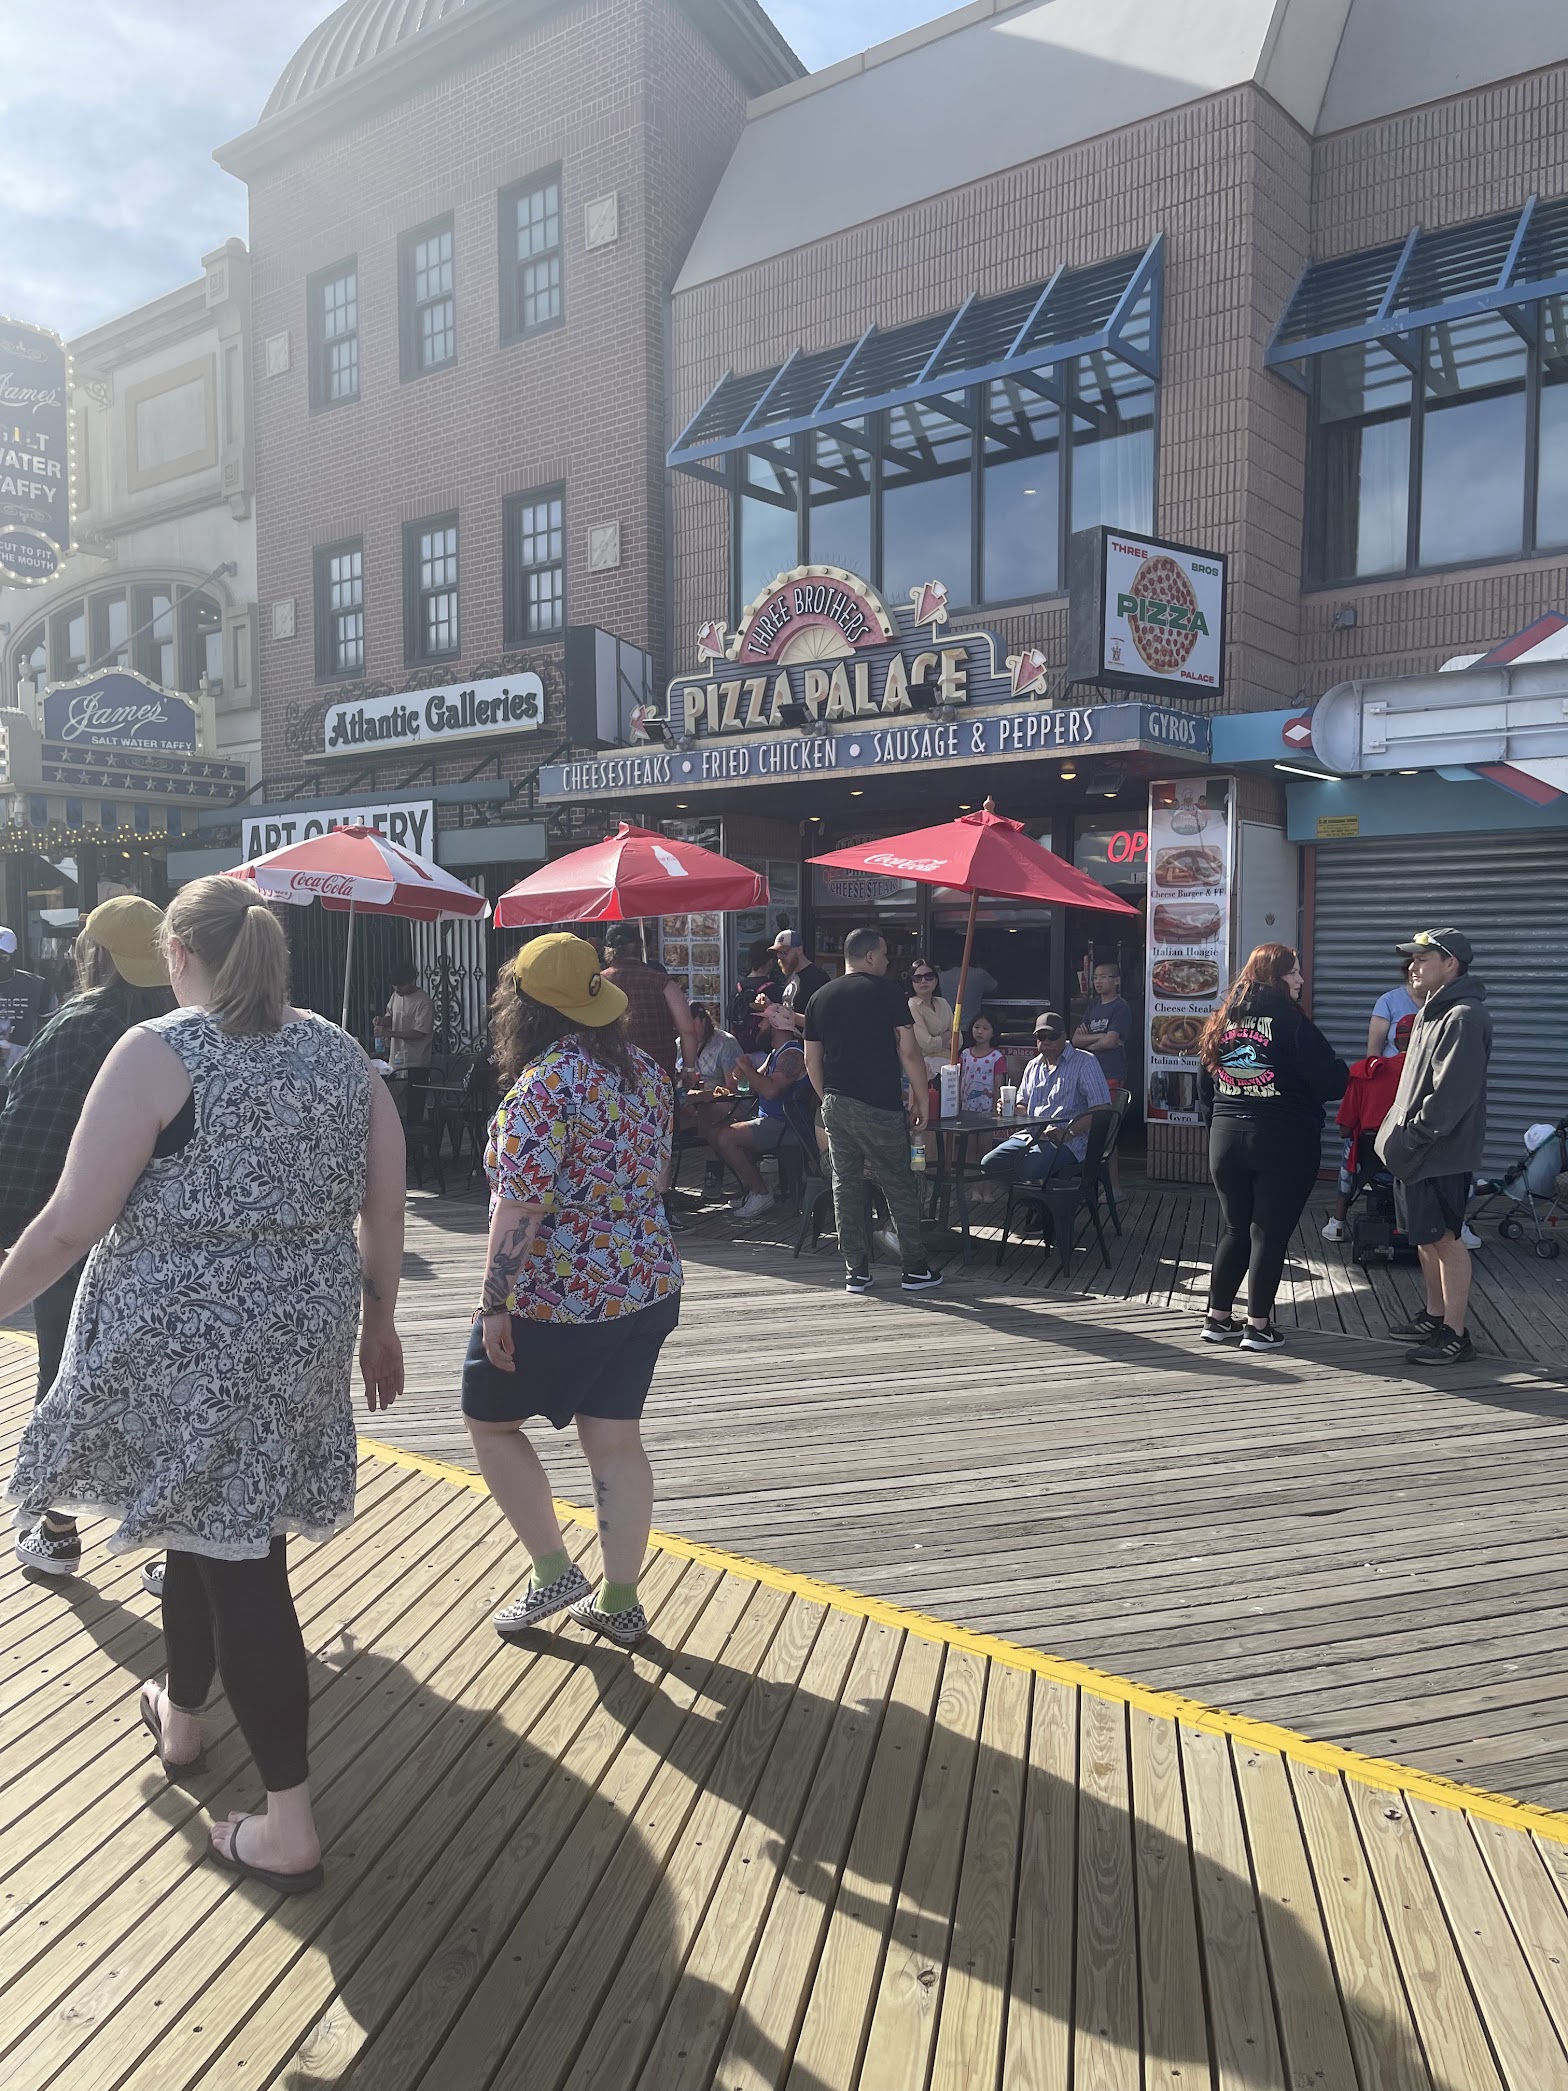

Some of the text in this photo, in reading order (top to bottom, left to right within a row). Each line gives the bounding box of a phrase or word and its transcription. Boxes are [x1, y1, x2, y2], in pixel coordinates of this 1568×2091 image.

[0, 475, 57, 503] AFFY
[20, 545, 34, 556] TO
[36, 548, 52, 559] FIT
[1112, 542, 1148, 559] THREE
[0, 552, 54, 570] HE MOUTH
[1191, 562, 1219, 577] BROS
[747, 585, 870, 655] THREE BROTHERS
[1117, 593, 1210, 636] PIZZA
[1180, 671, 1215, 684] PALACE
[683, 648, 969, 736] PIZZA PALACE
[328, 689, 538, 747] Atlantic Galleries
[1149, 711, 1196, 744] GYROS
[91, 736, 192, 750] SALT WATER TAFFY
[562, 708, 1093, 792] CHEESESTEAKS FRIED CHICKEN SAUSAGE & PEPPERS
[248, 821, 296, 862] ART
[1107, 831, 1149, 863] OP
[864, 854, 949, 872] Coca-Cola
[290, 872, 357, 896] Coca-Cola
[830, 879, 898, 899] CHEESE STEAK
[1178, 889, 1203, 899] Burger
[1153, 947, 1219, 958] Italian Hoagie
[1154, 1003, 1186, 1013] Cheese
[1008, 1048, 1034, 1056] Palace
[1150, 1056, 1178, 1065] Italian
